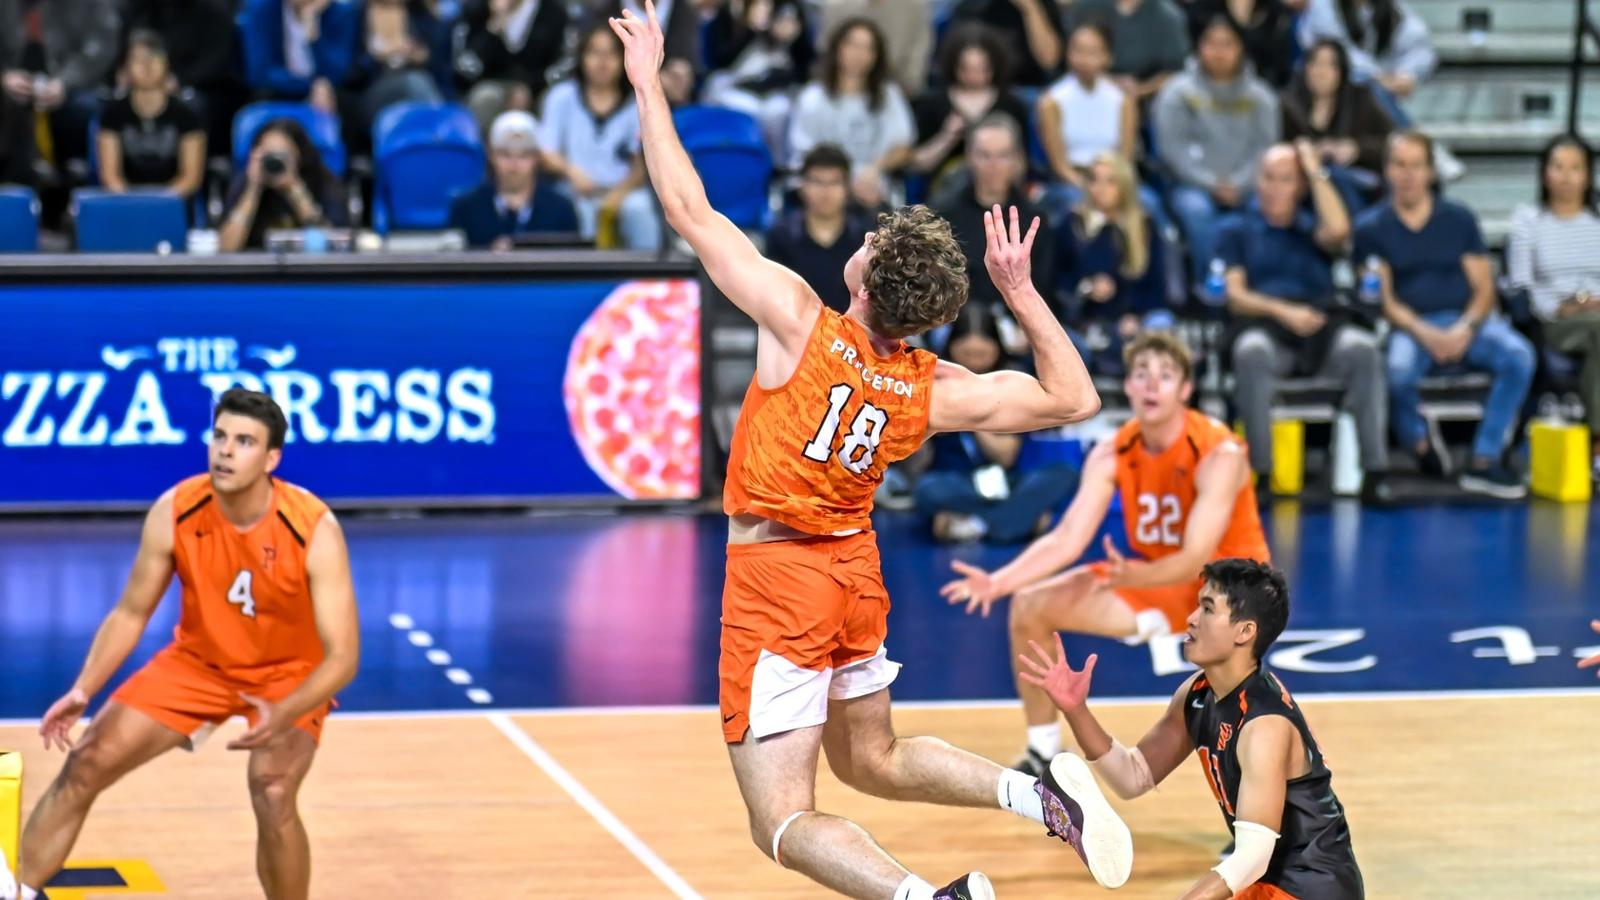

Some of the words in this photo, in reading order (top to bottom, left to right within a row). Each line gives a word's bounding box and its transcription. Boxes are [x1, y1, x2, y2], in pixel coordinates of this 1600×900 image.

[157, 337, 239, 372] THE
[829, 338, 913, 398] PRCETON
[1, 370, 187, 446] ZZA
[801, 382, 890, 475] 18
[1135, 492, 1181, 546] 22
[226, 568, 257, 619] 4
